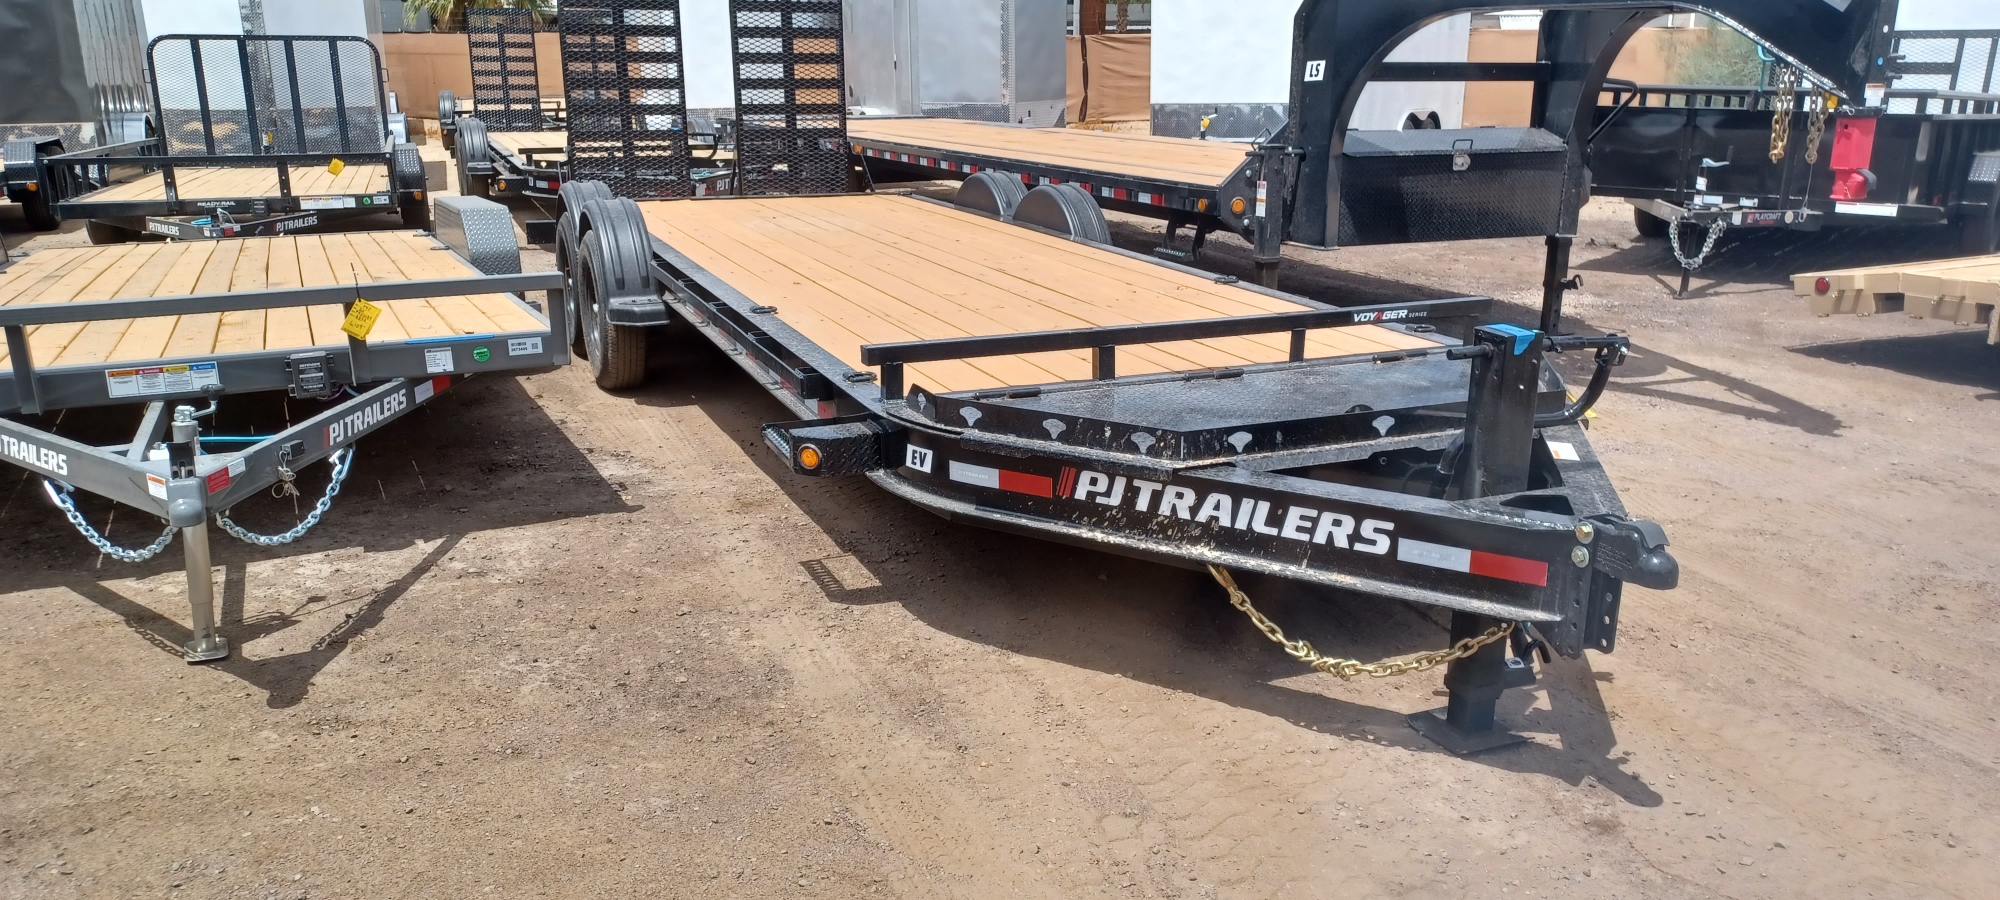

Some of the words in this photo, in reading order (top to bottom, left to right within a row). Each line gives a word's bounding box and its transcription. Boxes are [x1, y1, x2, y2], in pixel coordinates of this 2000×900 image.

[1309, 62, 1321, 78] LS
[155, 222, 180, 236] TRAILERS
[284, 215, 318, 230] TRAILERS
[1353, 310, 1408, 322] VOYAGER
[345, 388, 407, 437] TRAILERS
[1, 434, 68, 476] TRAILERS
[910, 448, 929, 469] EV
[1073, 470, 1127, 506] PJ
[1133, 479, 1395, 555] TRAILERS
